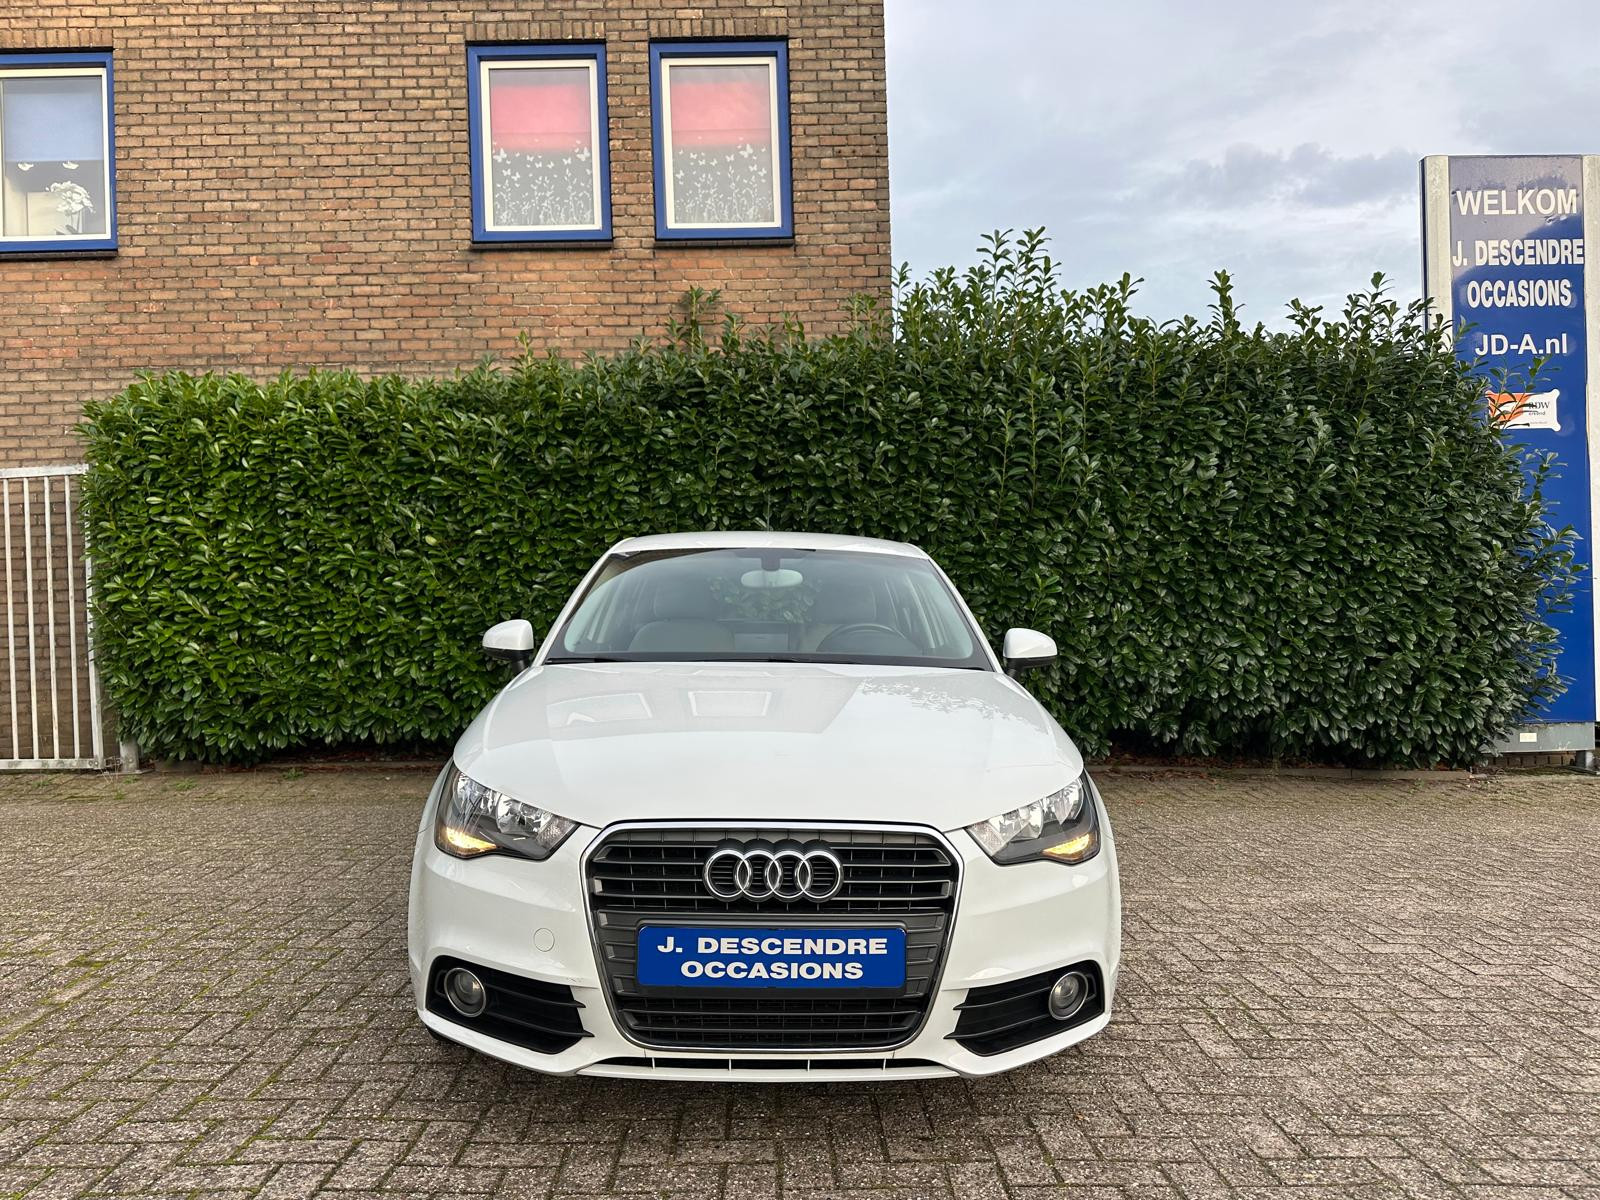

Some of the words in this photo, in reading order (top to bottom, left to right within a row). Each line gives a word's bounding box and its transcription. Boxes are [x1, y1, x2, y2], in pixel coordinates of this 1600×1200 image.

[1456, 189, 1577, 216] WELKOM
[1453, 240, 1467, 267] J.
[1475, 238, 1584, 266] DESCENDRE
[1467, 279, 1572, 308] OCCASIONS
[1475, 334, 1567, 356] JD-A.nl
[657, 937, 683, 952] J.
[698, 937, 887, 954] DESCENDRE
[681, 961, 863, 979] OCCASIONS
